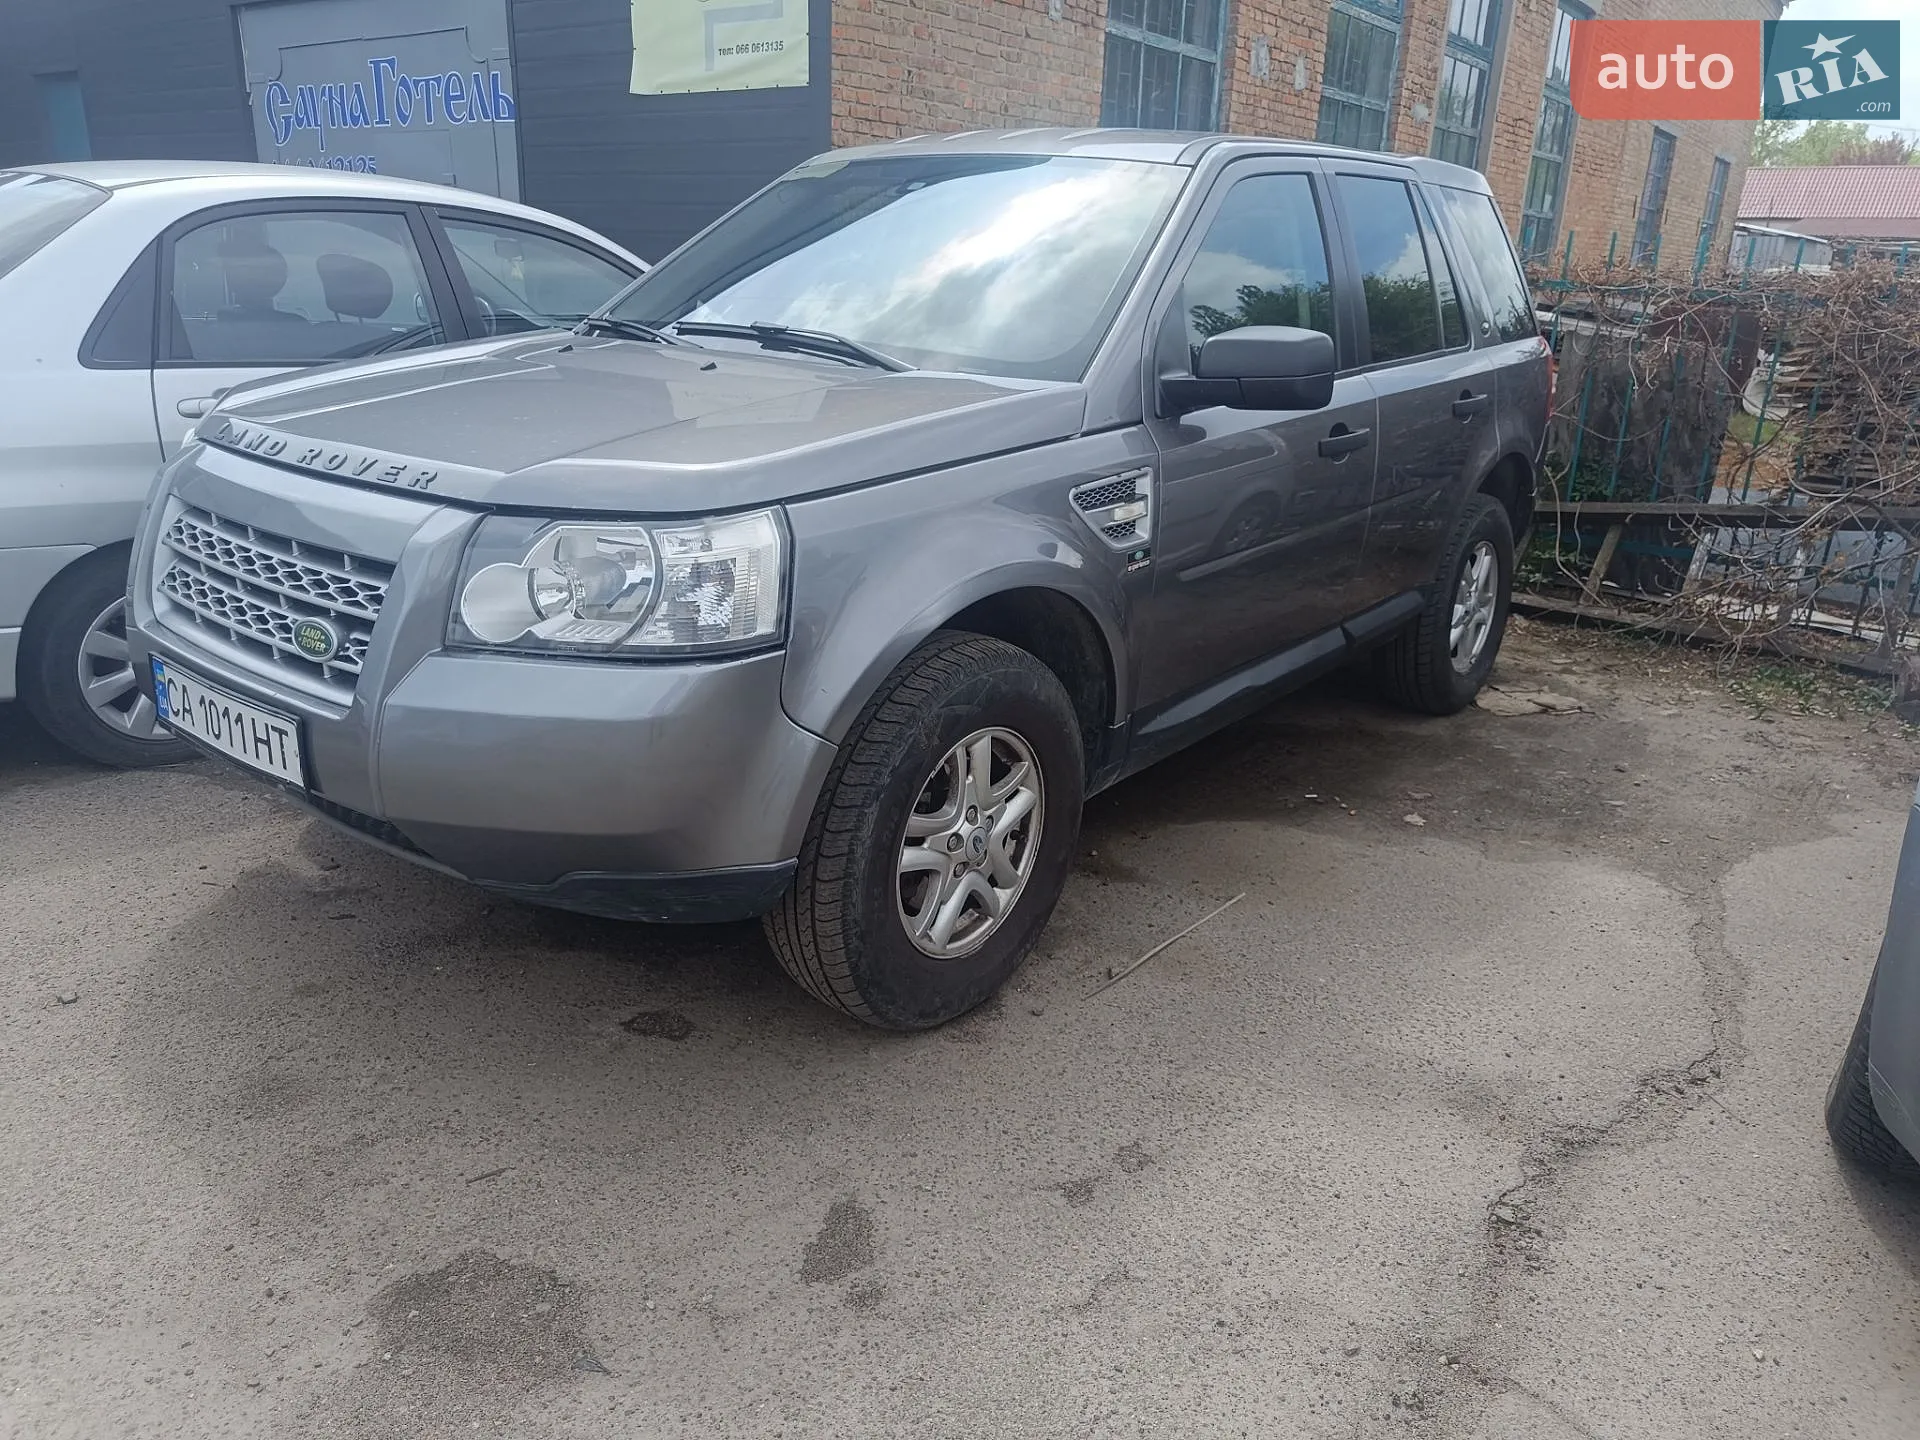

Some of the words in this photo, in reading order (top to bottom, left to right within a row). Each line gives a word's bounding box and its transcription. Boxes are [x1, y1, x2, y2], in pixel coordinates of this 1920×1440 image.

[735, 44, 750, 55] 066
[214, 422, 288, 457] LAND
[297, 447, 438, 490] ROVER
[301, 625, 321, 640] LAND
[301, 636, 326, 653] ROVER
[166, 677, 195, 727] CA
[199, 694, 248, 754] 1011
[251, 717, 289, 770] HT
